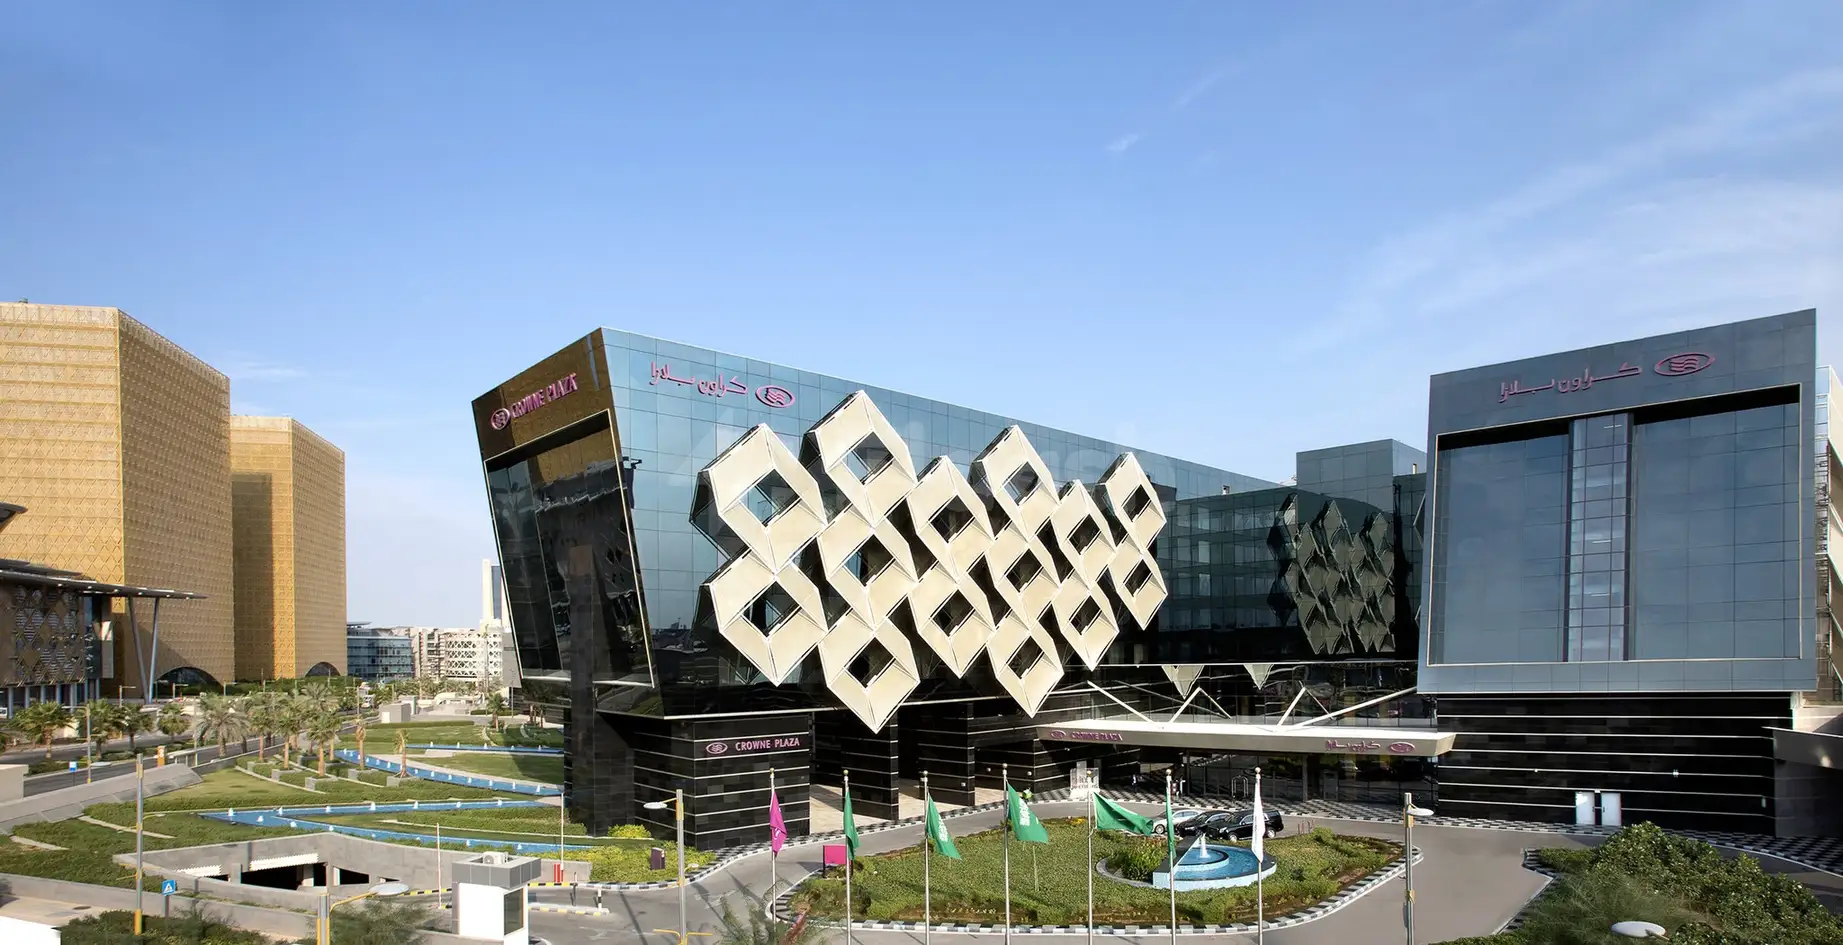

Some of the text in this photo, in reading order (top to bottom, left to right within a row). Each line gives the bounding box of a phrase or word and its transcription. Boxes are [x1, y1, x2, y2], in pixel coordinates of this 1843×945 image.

[546, 373, 578, 401] PLAZA
[649, 361, 748, 398] كراون بلازا
[1498, 362, 1643, 403] كراون بلازا
[735, 737, 800, 752] CROWNE PLAZA
